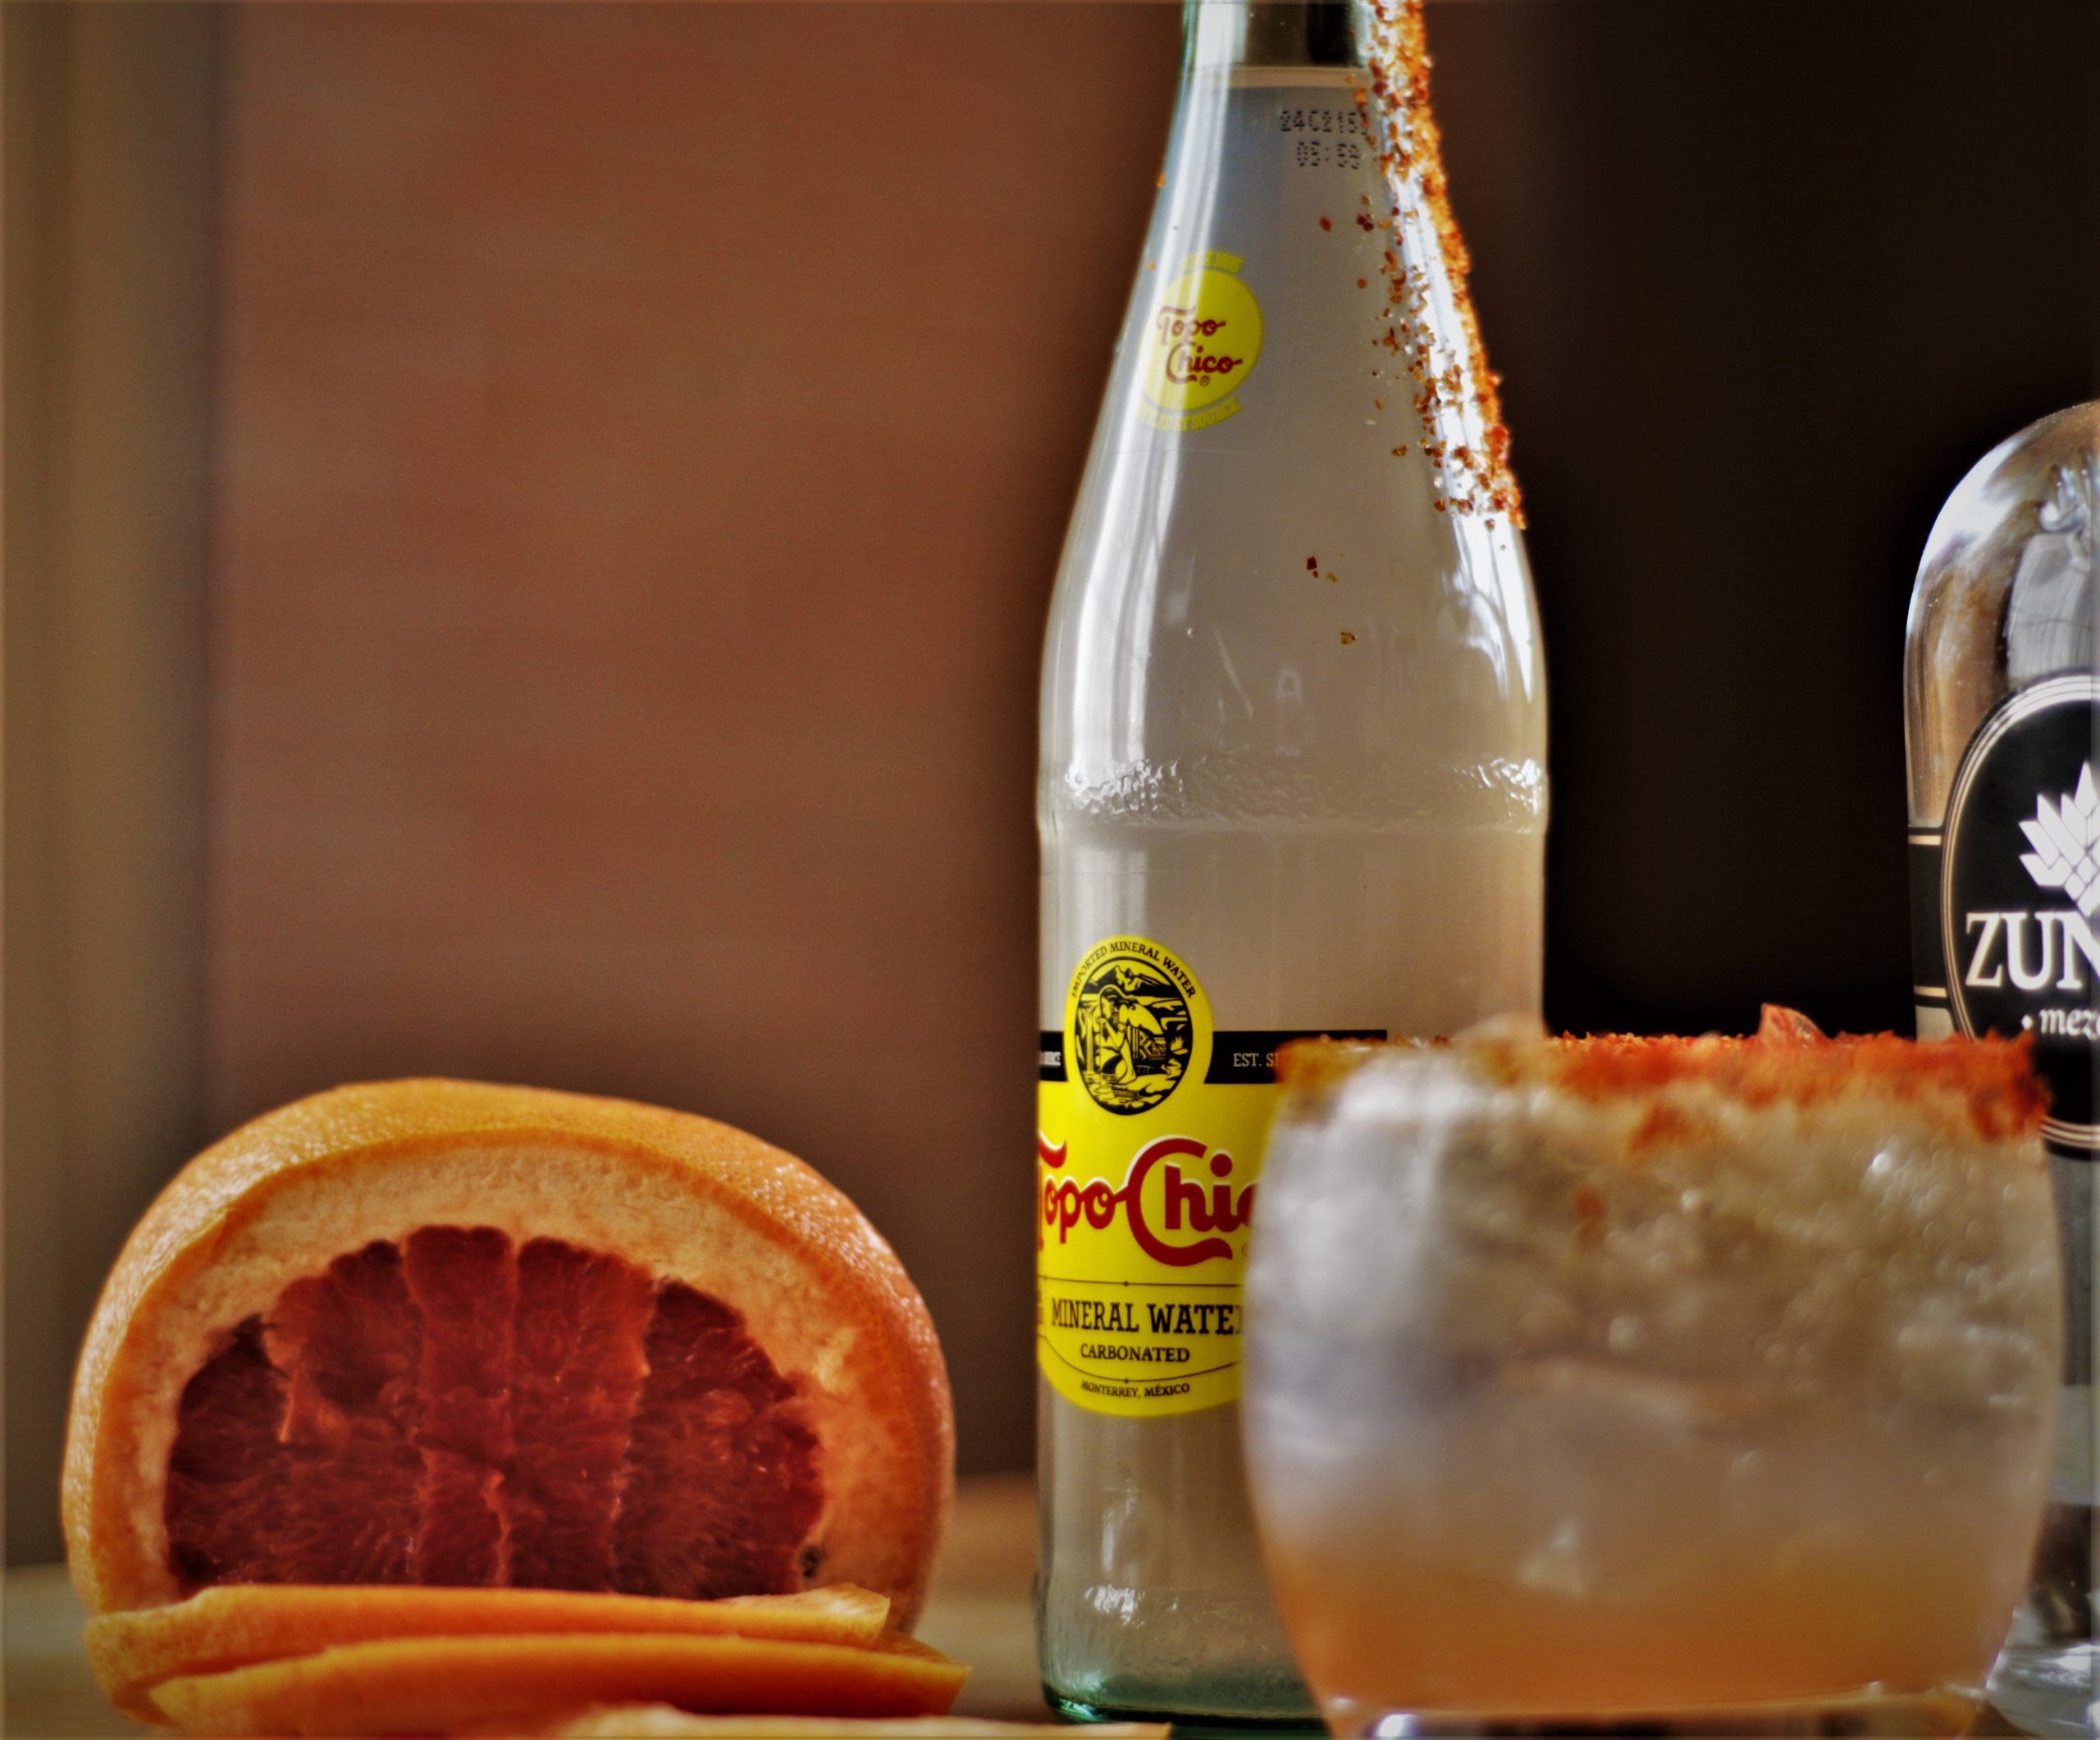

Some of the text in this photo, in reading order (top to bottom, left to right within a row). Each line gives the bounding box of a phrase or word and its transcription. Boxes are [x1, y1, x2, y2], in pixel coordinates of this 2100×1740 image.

[1296, 141, 1359, 170] 05:59
[1157, 304, 1226, 347] Topo
[1165, 341, 1244, 385] Chico
[1965, 910, 2100, 991] ZUN
[1071, 941, 1196, 998] IMPORTED MINERAL WATER
[2038, 1007, 2100, 1041] mez
[1232, 1053, 1262, 1067] EST.
[1125, 1135, 1260, 1267] Chic
[1051, 1297, 1139, 1332] MINERAL
[1080, 1343, 1191, 1363] CARBONATED
[1080, 1379, 1190, 1400] MONTERREY, MÉXICO
